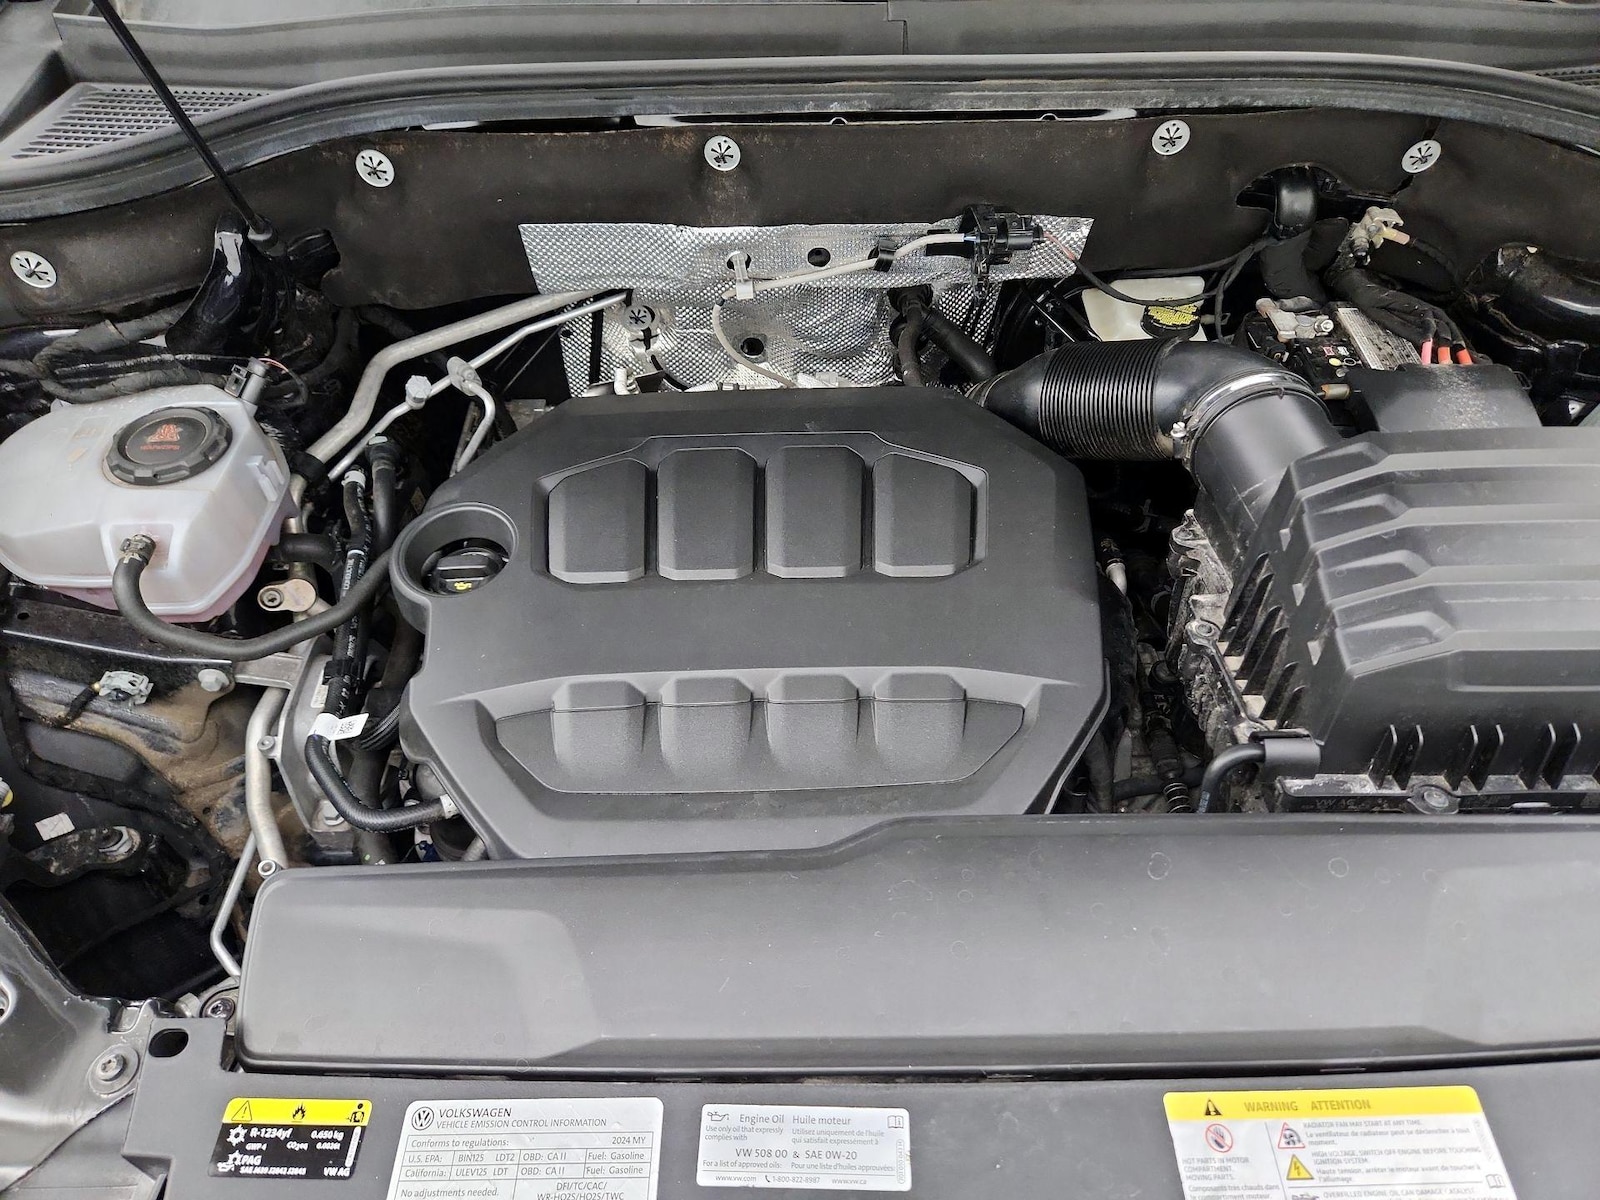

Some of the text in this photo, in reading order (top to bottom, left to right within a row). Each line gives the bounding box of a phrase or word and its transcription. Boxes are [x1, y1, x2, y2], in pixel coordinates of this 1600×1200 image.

[1244, 1099, 1372, 1112] WARNING ATTENTION
[439, 1107, 512, 1118] VOLKSWAGEN
[437, 1118, 607, 1129] VEHICLE EMISSION CONTROL INFORMATION
[740, 1114, 785, 1125] Engine Oil
[792, 1115, 851, 1125] Huile moteur
[1363, 1120, 1382, 1128] START
[250, 1127, 344, 1141] R-1234yf 0.650 kg
[718, 1125, 732, 1134] only
[732, 1125, 741, 1133] oil
[755, 1126, 784, 1135] expressly
[792, 1128, 815, 1136] Utilisez
[817, 1129, 855, 1138] uniquement
[612, 1136, 646, 1145] 2024 MY
[704, 1134, 732, 1142] complies
[791, 1136, 802, 1145] qui
[803, 1136, 828, 1144] satisfait
[411, 1138, 509, 1149] Conforms to regulations:
[408, 1154, 443, 1163] U.S. EPA:
[458, 1153, 515, 1162] BIN125 LDT2
[523, 1152, 544, 1161] OBD:
[547, 1152, 560, 1160] CA
[588, 1151, 645, 1160] Fuel: Gasoline
[735, 1148, 858, 1160] VW 508 00 & SAE 0W-20
[243, 1155, 262, 1165] PAG
[719, 1160, 730, 1168] list
[730, 1160, 738, 1168] of
[737, 1161, 768, 1169] approved
[768, 1161, 782, 1169] oils:
[521, 1167, 541, 1175] OBD:
[545, 1166, 559, 1175] CA
[586, 1166, 644, 1174] Fuel: Gasoline
[791, 1162, 806, 1170] Pour
[806, 1162, 819, 1170] une
[819, 1162, 833, 1170] liste
[323, 1167, 338, 1176] VW
[337, 1168, 350, 1177] AG
[405, 1166, 447, 1177] California:
[455, 1167, 508, 1176] ULEV125 LDT
[772, 1175, 821, 1183] 1-800-822-8987
[556, 1182, 608, 1191] DFI/TC/CAC/
[401, 1187, 499, 1200] No adjustments needed.
